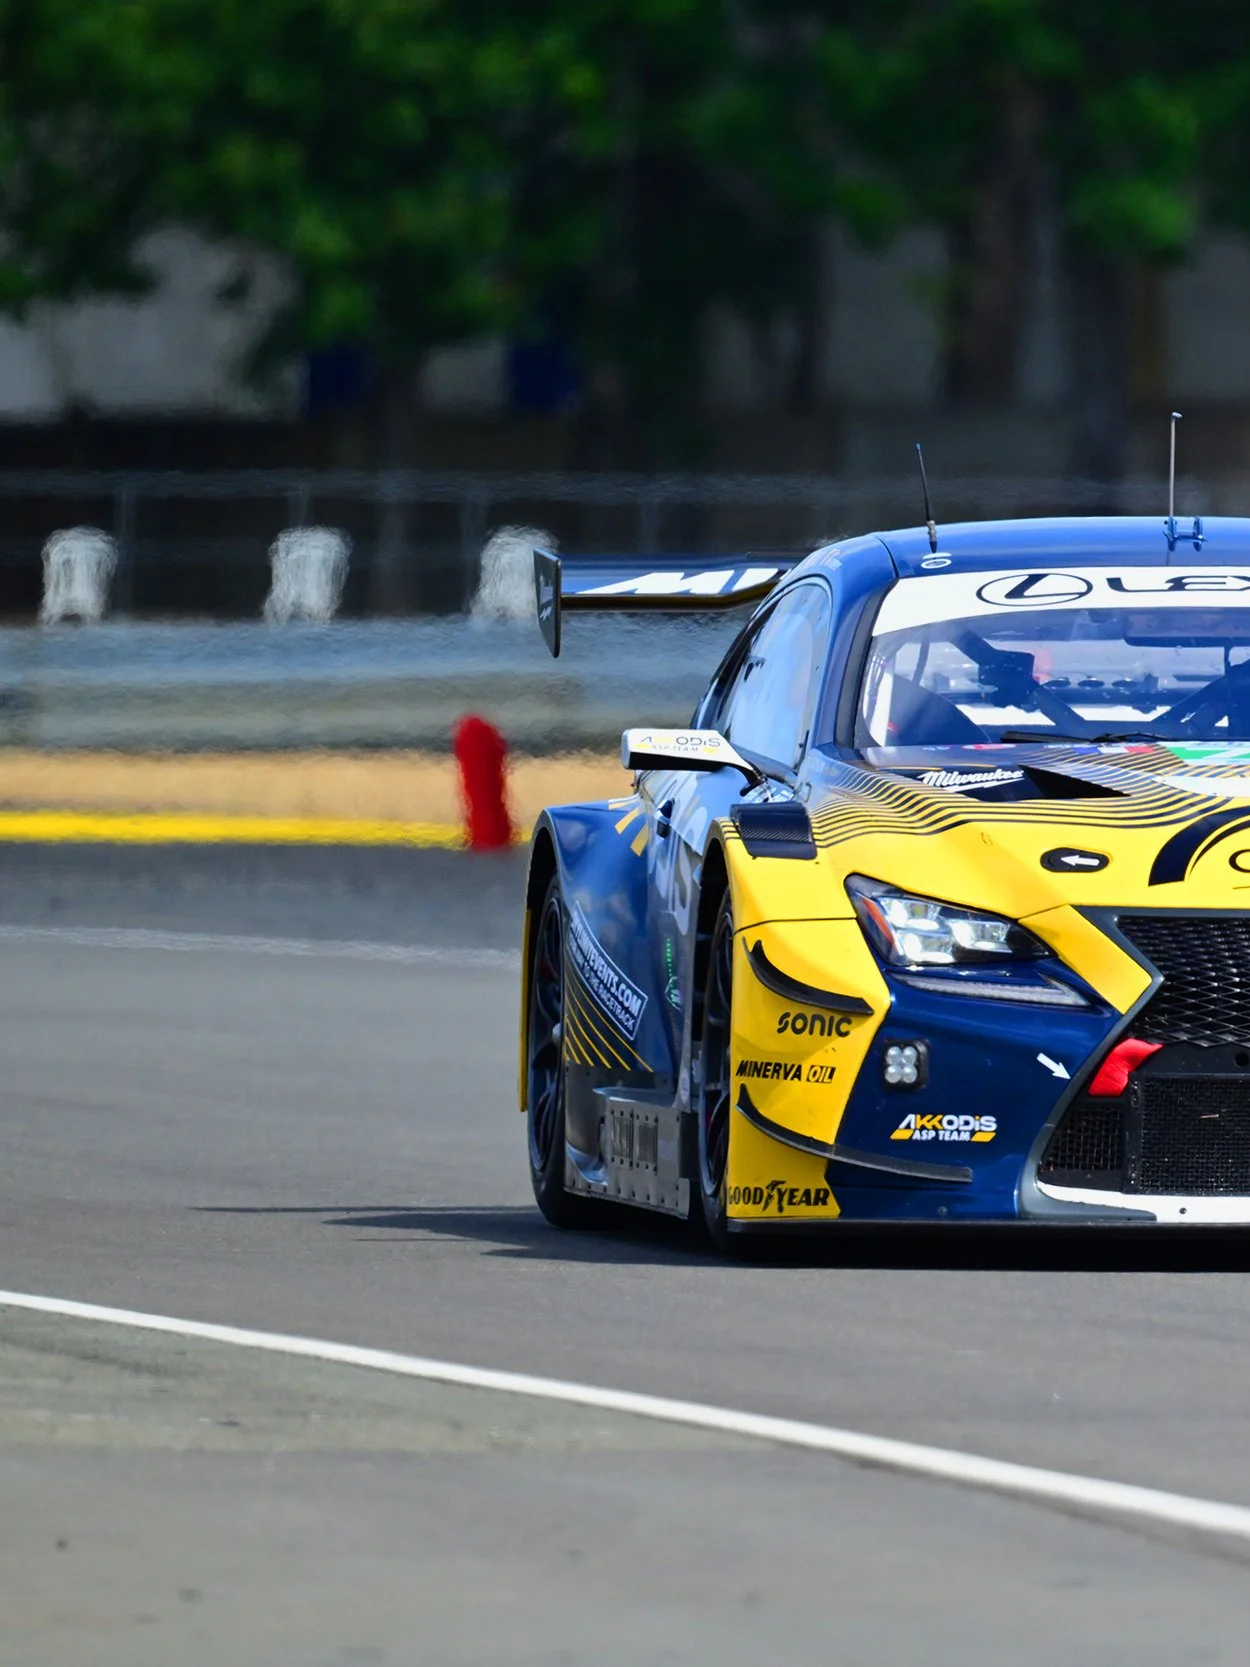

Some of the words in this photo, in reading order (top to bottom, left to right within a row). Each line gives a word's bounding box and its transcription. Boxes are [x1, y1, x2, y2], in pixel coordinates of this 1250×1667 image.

[640, 736, 721, 748] AODiS
[917, 768, 1025, 789] Milwaukee
[736, 1060, 803, 1081] MINERVA
[806, 1065, 836, 1084] OIL
[912, 1130, 936, 1141] ASP
[938, 1130, 971, 1141] TEAM
